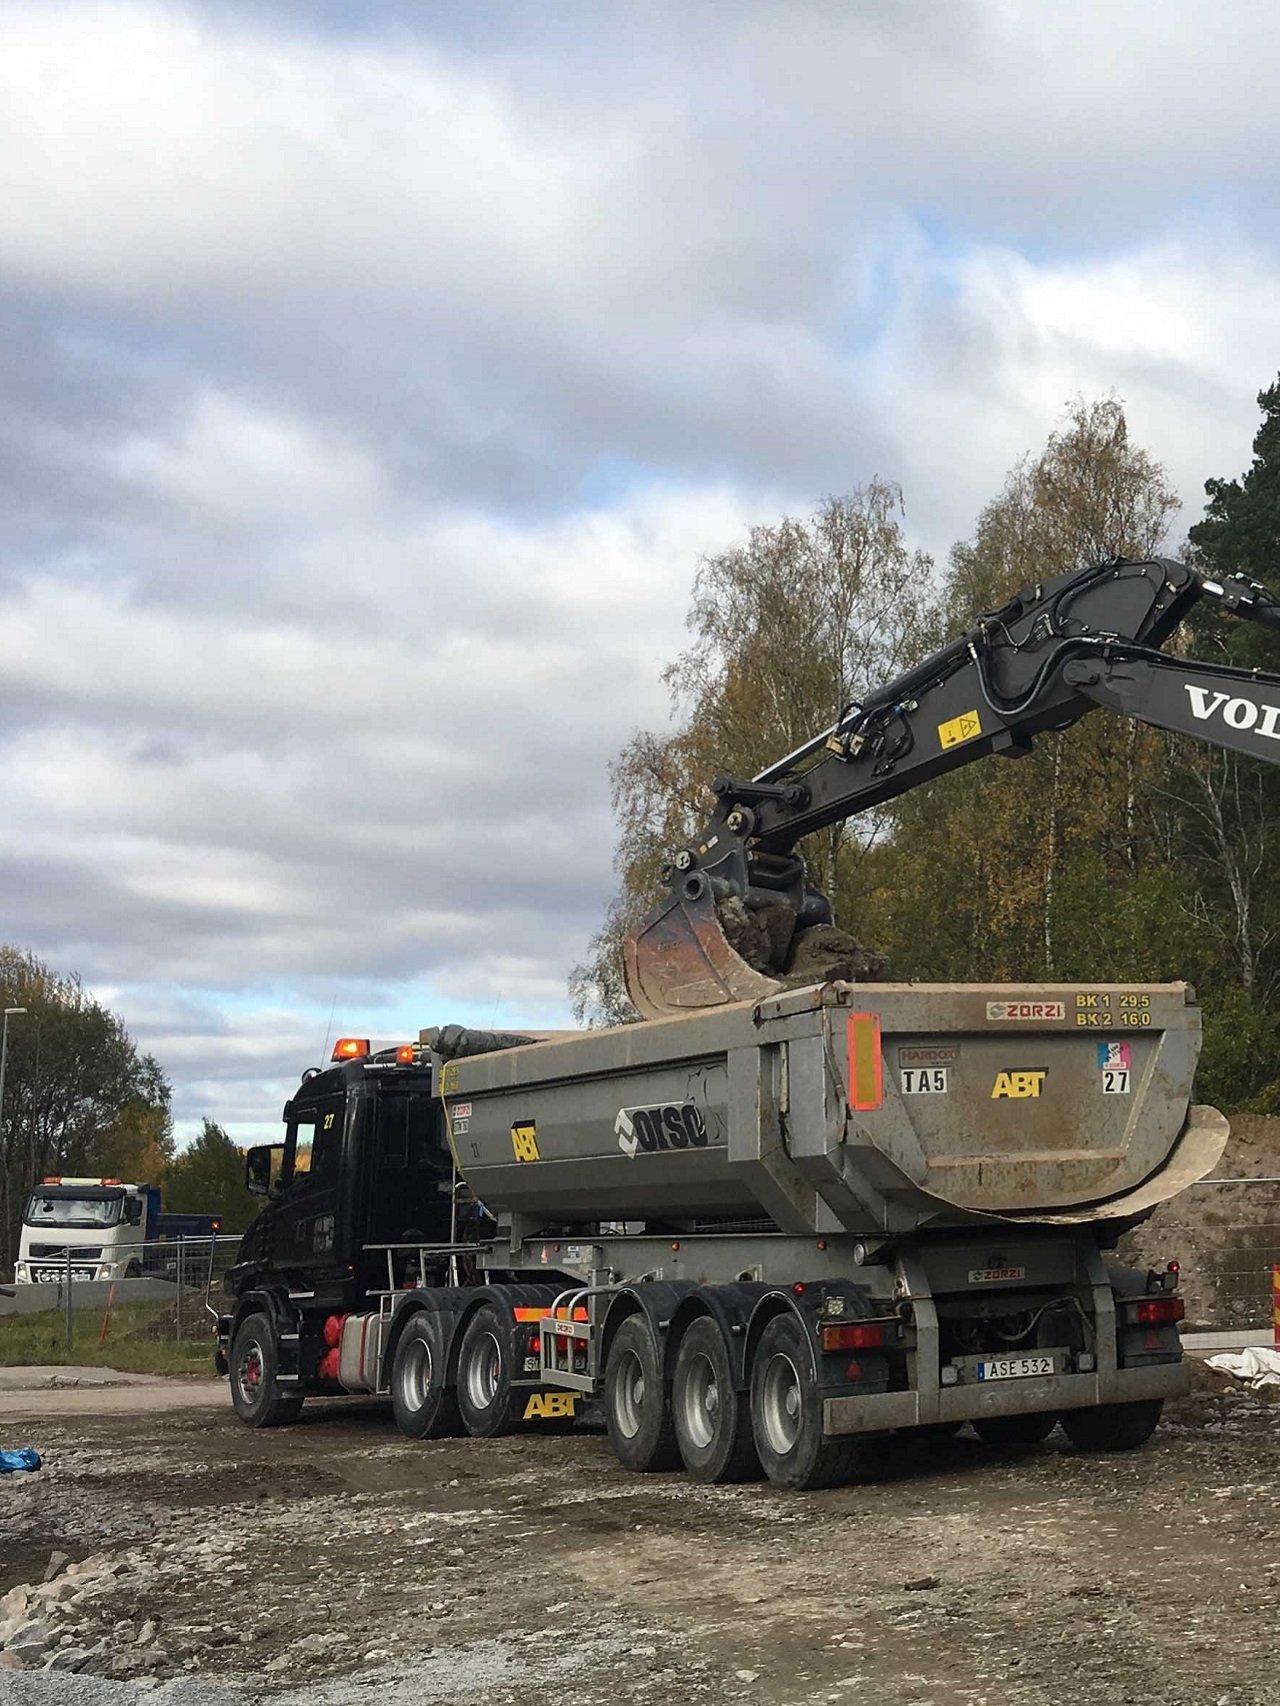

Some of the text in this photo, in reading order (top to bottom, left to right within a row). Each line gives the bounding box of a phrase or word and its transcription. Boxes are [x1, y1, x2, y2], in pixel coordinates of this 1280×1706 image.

[1076, 994, 1150, 1009] BK 1 29,5
[1007, 1004, 1061, 1017] ZORZI
[1077, 1013, 1151, 1028] BK 2 16,0
[901, 1050, 956, 1061] HARDOX
[991, 1071, 1046, 1099] ABT
[1105, 1072, 1127, 1092] 27
[323, 1113, 335, 1130] 27
[511, 1126, 540, 1163] ABT
[984, 1269, 1021, 1280] ZORZI
[990, 1358, 1049, 1377] ASE 532
[523, 1392, 581, 1420] ABT
